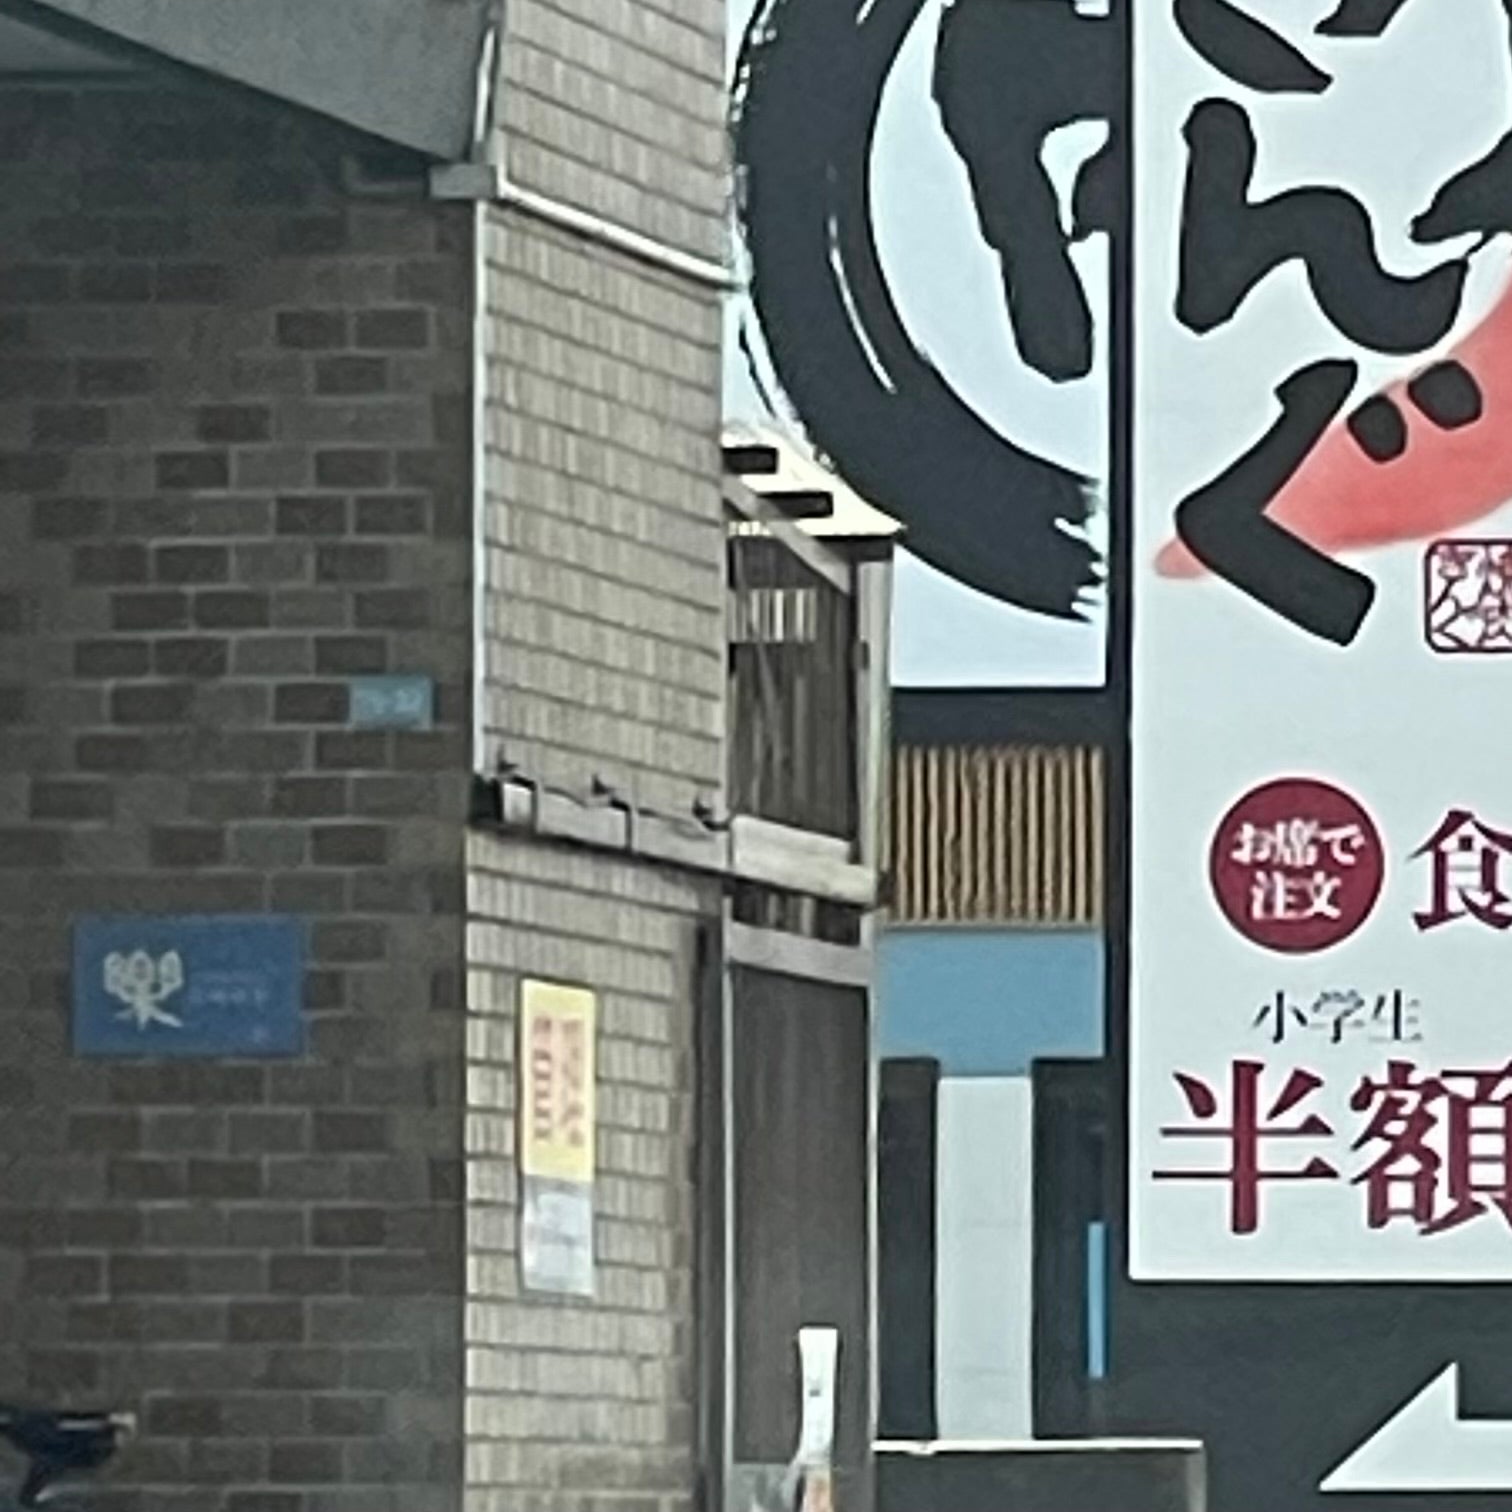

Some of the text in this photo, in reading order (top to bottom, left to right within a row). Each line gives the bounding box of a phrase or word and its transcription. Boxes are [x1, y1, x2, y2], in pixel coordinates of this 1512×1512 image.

[1231, 817, 1366, 868] お席で
[1251, 871, 1342, 920] 注文
[1252, 988, 1424, 1045] 小学生
